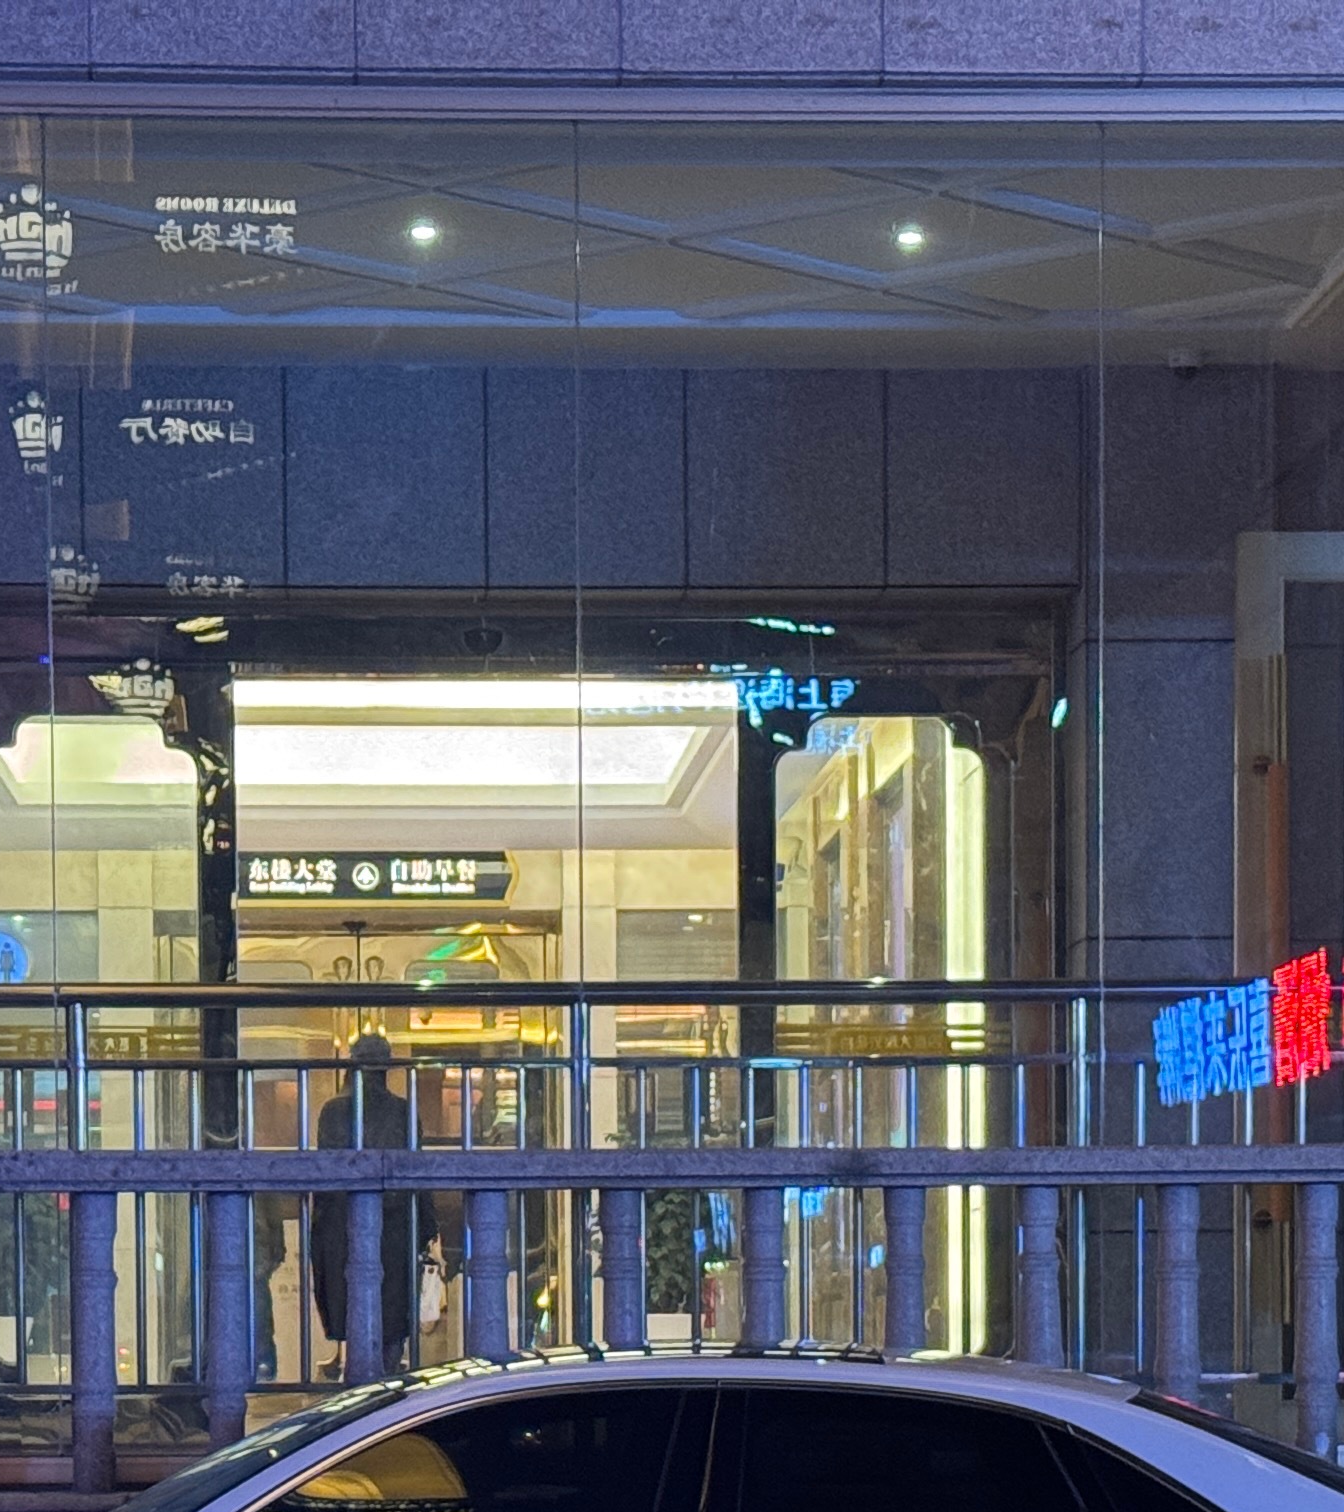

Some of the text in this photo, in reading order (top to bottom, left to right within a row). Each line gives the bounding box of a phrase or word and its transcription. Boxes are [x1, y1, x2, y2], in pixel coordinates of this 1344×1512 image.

[248, 857, 337, 881] 东楼大堂
[389, 858, 477, 881] 自助早餐
